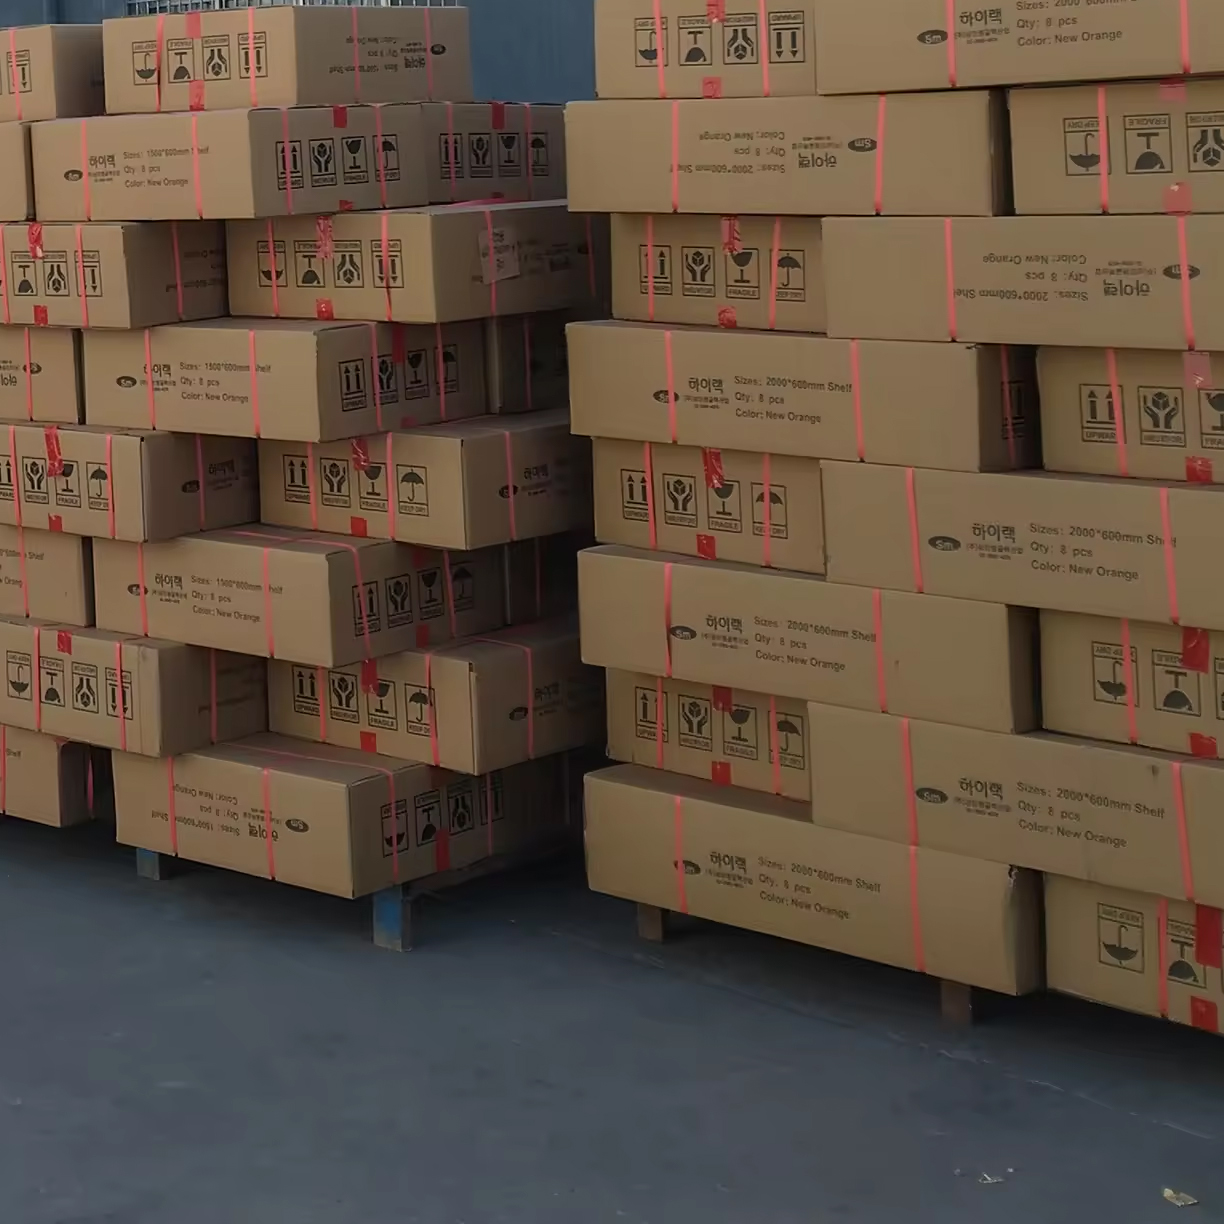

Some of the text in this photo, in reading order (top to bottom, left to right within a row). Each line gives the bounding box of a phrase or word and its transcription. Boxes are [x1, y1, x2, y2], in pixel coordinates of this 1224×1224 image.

[1016, 1, 1049, 11] Sizes:
[960, 8, 1002, 26] 하이랙
[1017, 17, 1078, 30] Qty: 8 pcs
[1017, 30, 1122, 47] Color: New Orange
[1128, 118, 1167, 126] FRAGILE
[699, 131, 785, 141] Color: New Orange
[734, 147, 751, 155] pcs
[766, 148, 786, 157] Qty:
[89, 154, 115, 168] 하이랙
[798, 153, 837, 168] 하이랙
[758, 164, 786, 173] Sizes:
[983, 253, 1087, 264] Color: New Orange
[1025, 272, 1045, 280] pcs
[1063, 272, 1087, 283] Qty:
[728, 288, 756, 296] FRAGILE
[1103, 279, 1150, 297] 하이랙
[1055, 290, 1088, 301] Sizes:
[180, 362, 201, 370] Sizes:
[181, 377, 196, 386] Qty:
[207, 379, 220, 387] pcs
[688, 377, 723, 394] 하이랙
[734, 376, 762, 386] Sizes:
[827, 382, 852, 393] Shelf
[181, 392, 203, 400] Color:
[222, 394, 248, 404] Orange
[769, 396, 784, 405] pcs
[736, 408, 821, 424] Color: New Orange
[1086, 431, 1117, 440] UPWAR
[711, 520, 738, 530] FRAGILE
[1030, 523, 1064, 536] Sizes:
[972, 522, 1016, 543] 하이랙
[1030, 541, 1053, 554] Qty:
[1073, 547, 1093, 557] pcs
[1031, 560, 1138, 581] Color: New Orange
[155, 573, 183, 590] 하이랙
[192, 590, 207, 601] Qty:
[219, 594, 231, 603] pcs
[217, 609, 232, 618] New
[234, 611, 260, 623] Orange
[706, 615, 743, 634] 하이랙
[790, 639, 807, 649] pcs
[756, 650, 845, 672] Color: New Orange
[199, 791, 213, 800] New
[959, 778, 1003, 801] 하이랙
[216, 795, 238, 805] Color:
[1017, 782, 1052, 797] Sizes:
[1135, 803, 1165, 819] Shelf
[152, 810, 168, 821] Shelf
[200, 805, 212, 813] pcs
[224, 810, 238, 820] Qty:
[1018, 801, 1040, 814] Qty:
[1061, 810, 1080, 822] pcs
[1018, 819, 1127, 848] Color: New Orange
[710, 851, 747, 874] 하이랙
[794, 883, 811, 894] pcs
[856, 878, 880, 893] Shelf
[760, 891, 850, 919] Color: New Orange
